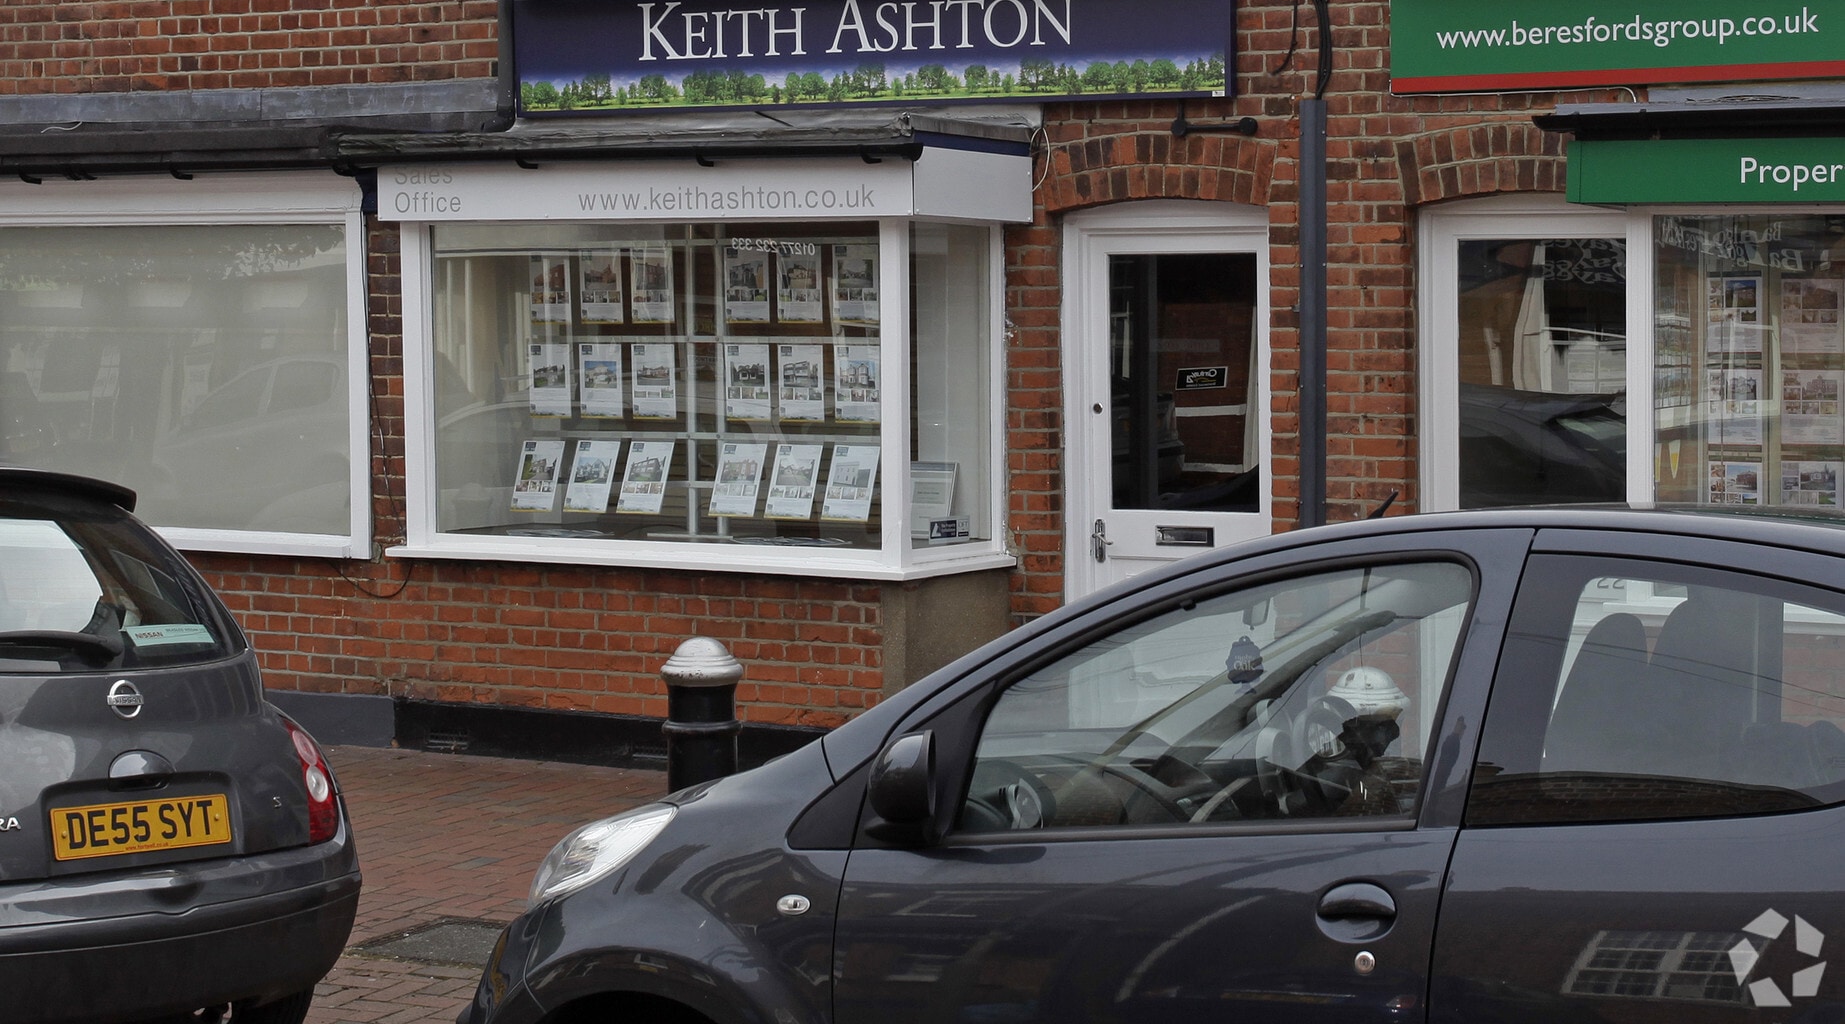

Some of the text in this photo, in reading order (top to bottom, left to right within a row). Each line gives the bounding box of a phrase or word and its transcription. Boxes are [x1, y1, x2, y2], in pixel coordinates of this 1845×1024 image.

[636, 1, 807, 61] KEITH
[1435, 6, 1820, 49] www.beresfordsgroup.co.uk
[394, 165, 453, 185] Sales
[1740, 157, 1845, 191] Proper
[394, 191, 462, 214] Office
[577, 184, 876, 212] www.keithashton.co.uk
[135, 631, 164, 639] NISSAN
[65, 800, 213, 851] DE55 SYT
